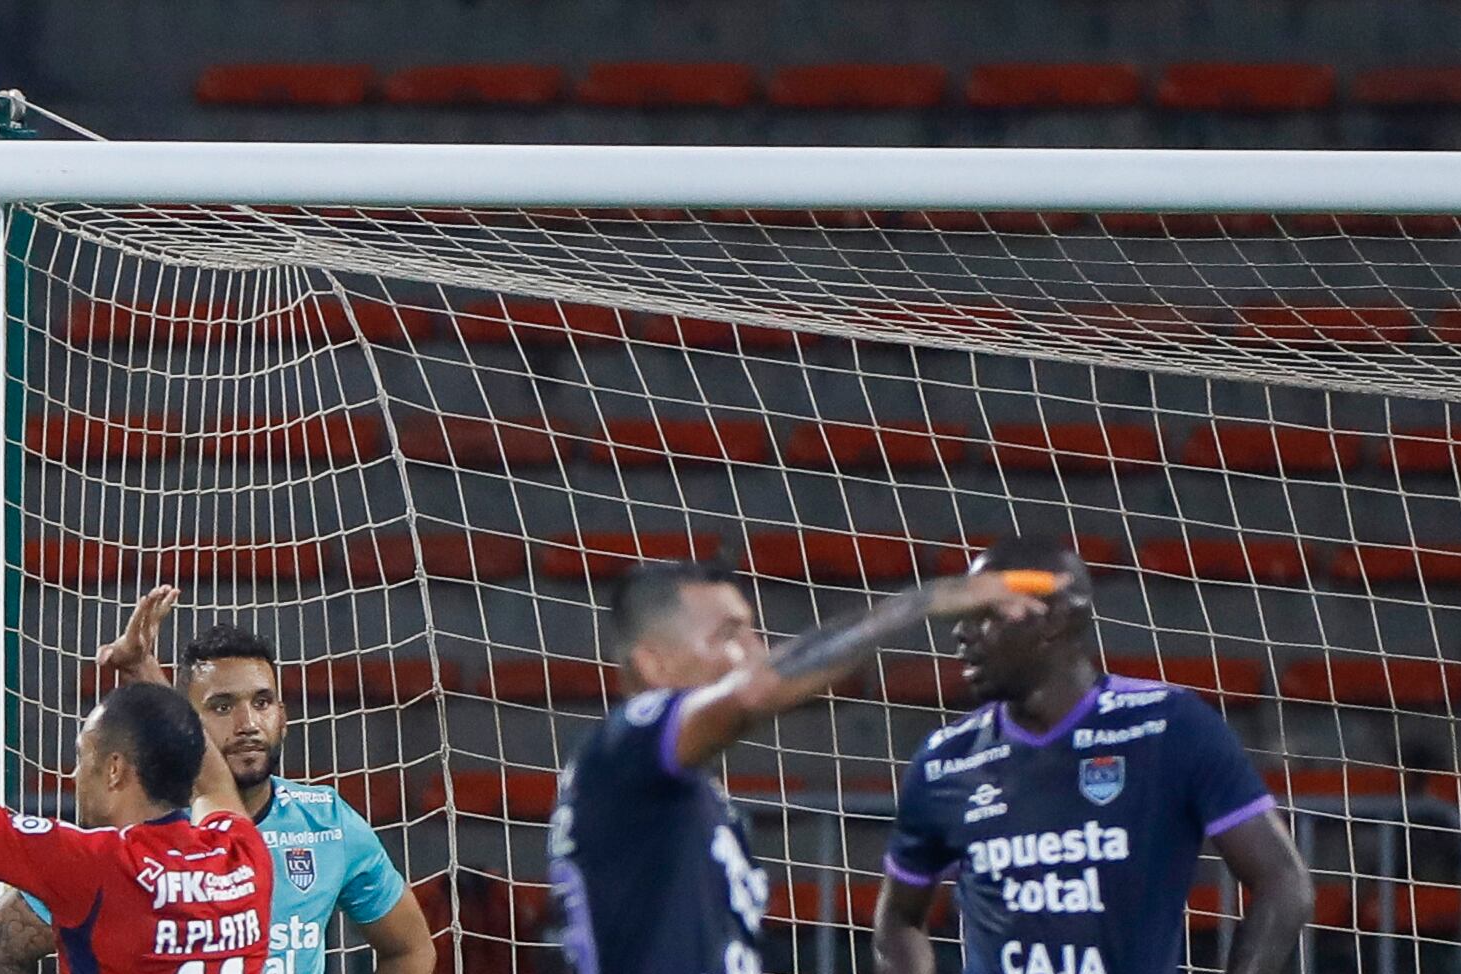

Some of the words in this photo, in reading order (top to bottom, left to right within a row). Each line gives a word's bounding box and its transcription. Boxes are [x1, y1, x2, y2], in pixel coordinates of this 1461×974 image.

[968, 820, 1130, 881] apuesta
[153, 871, 209, 909] JFK
[154, 909, 261, 955] A.PLATA
